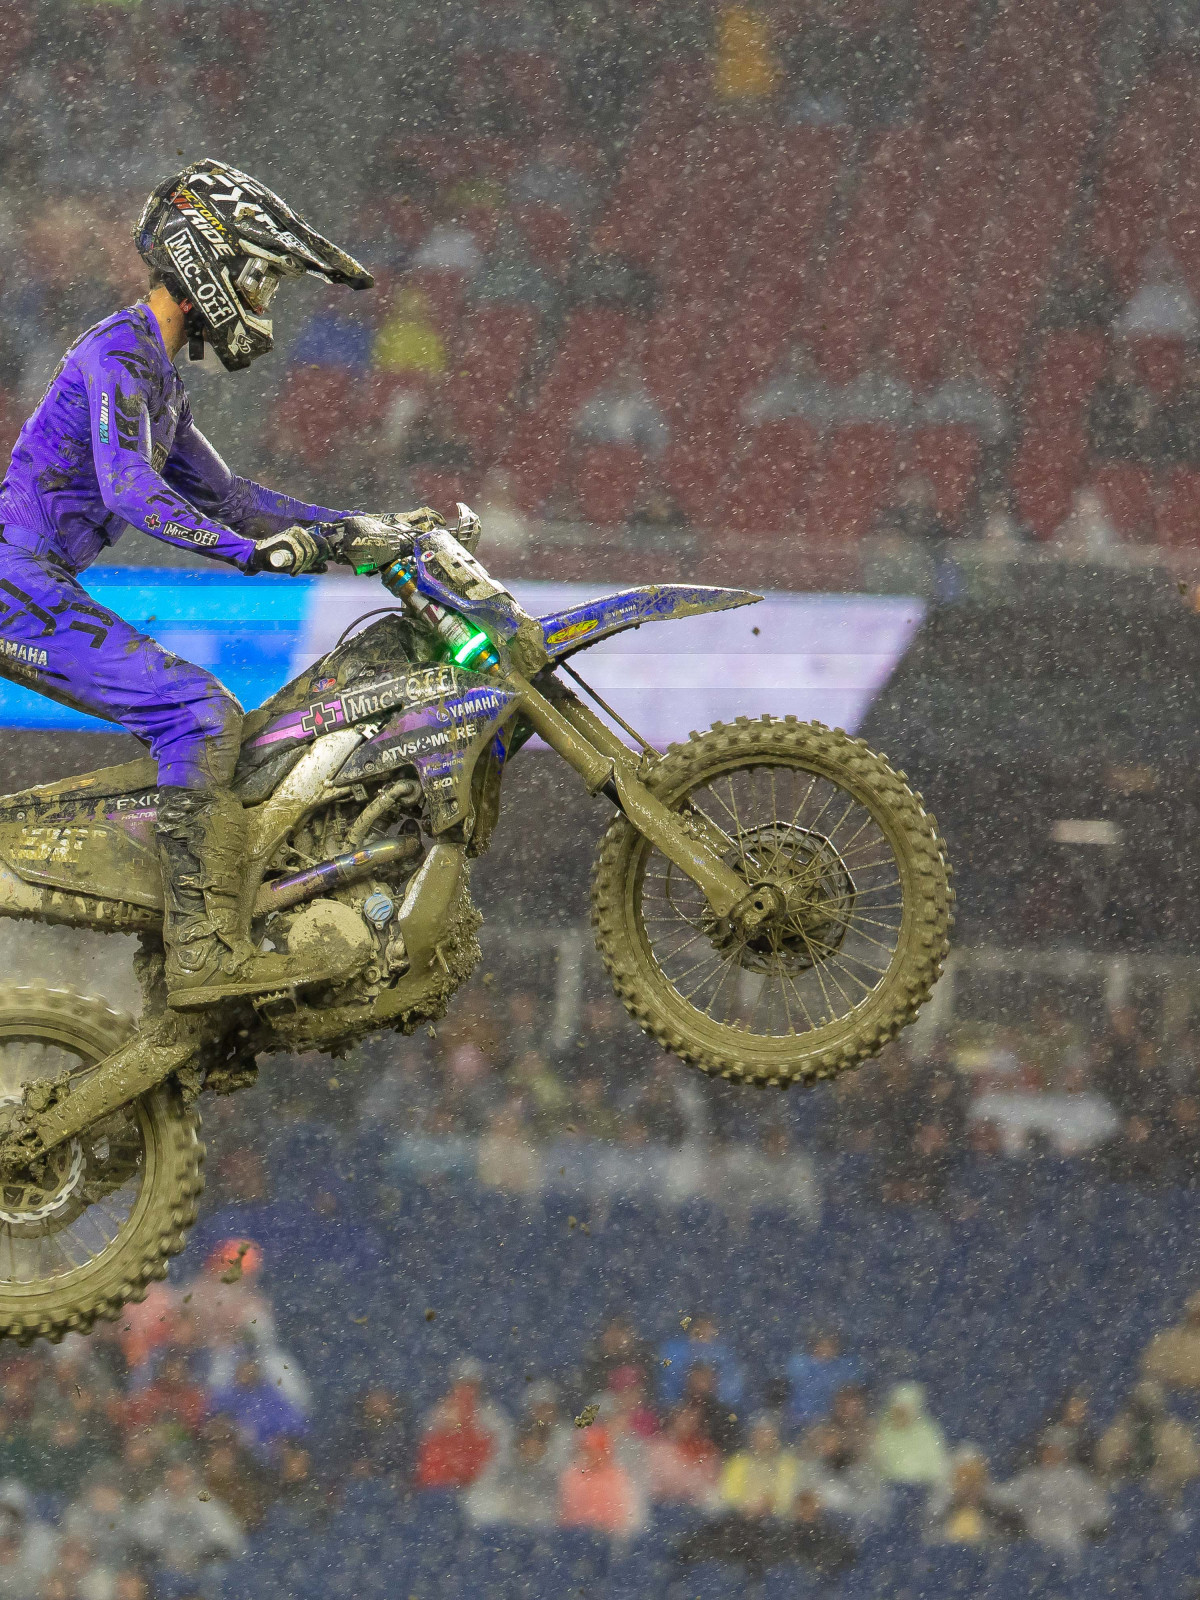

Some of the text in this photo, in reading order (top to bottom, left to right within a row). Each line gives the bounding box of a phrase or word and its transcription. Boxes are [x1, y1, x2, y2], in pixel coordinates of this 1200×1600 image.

[168, 234, 233, 322] Muc-Off
[165, 523, 217, 547] Muc-Off
[449, 694, 499, 718] YAMAHA
